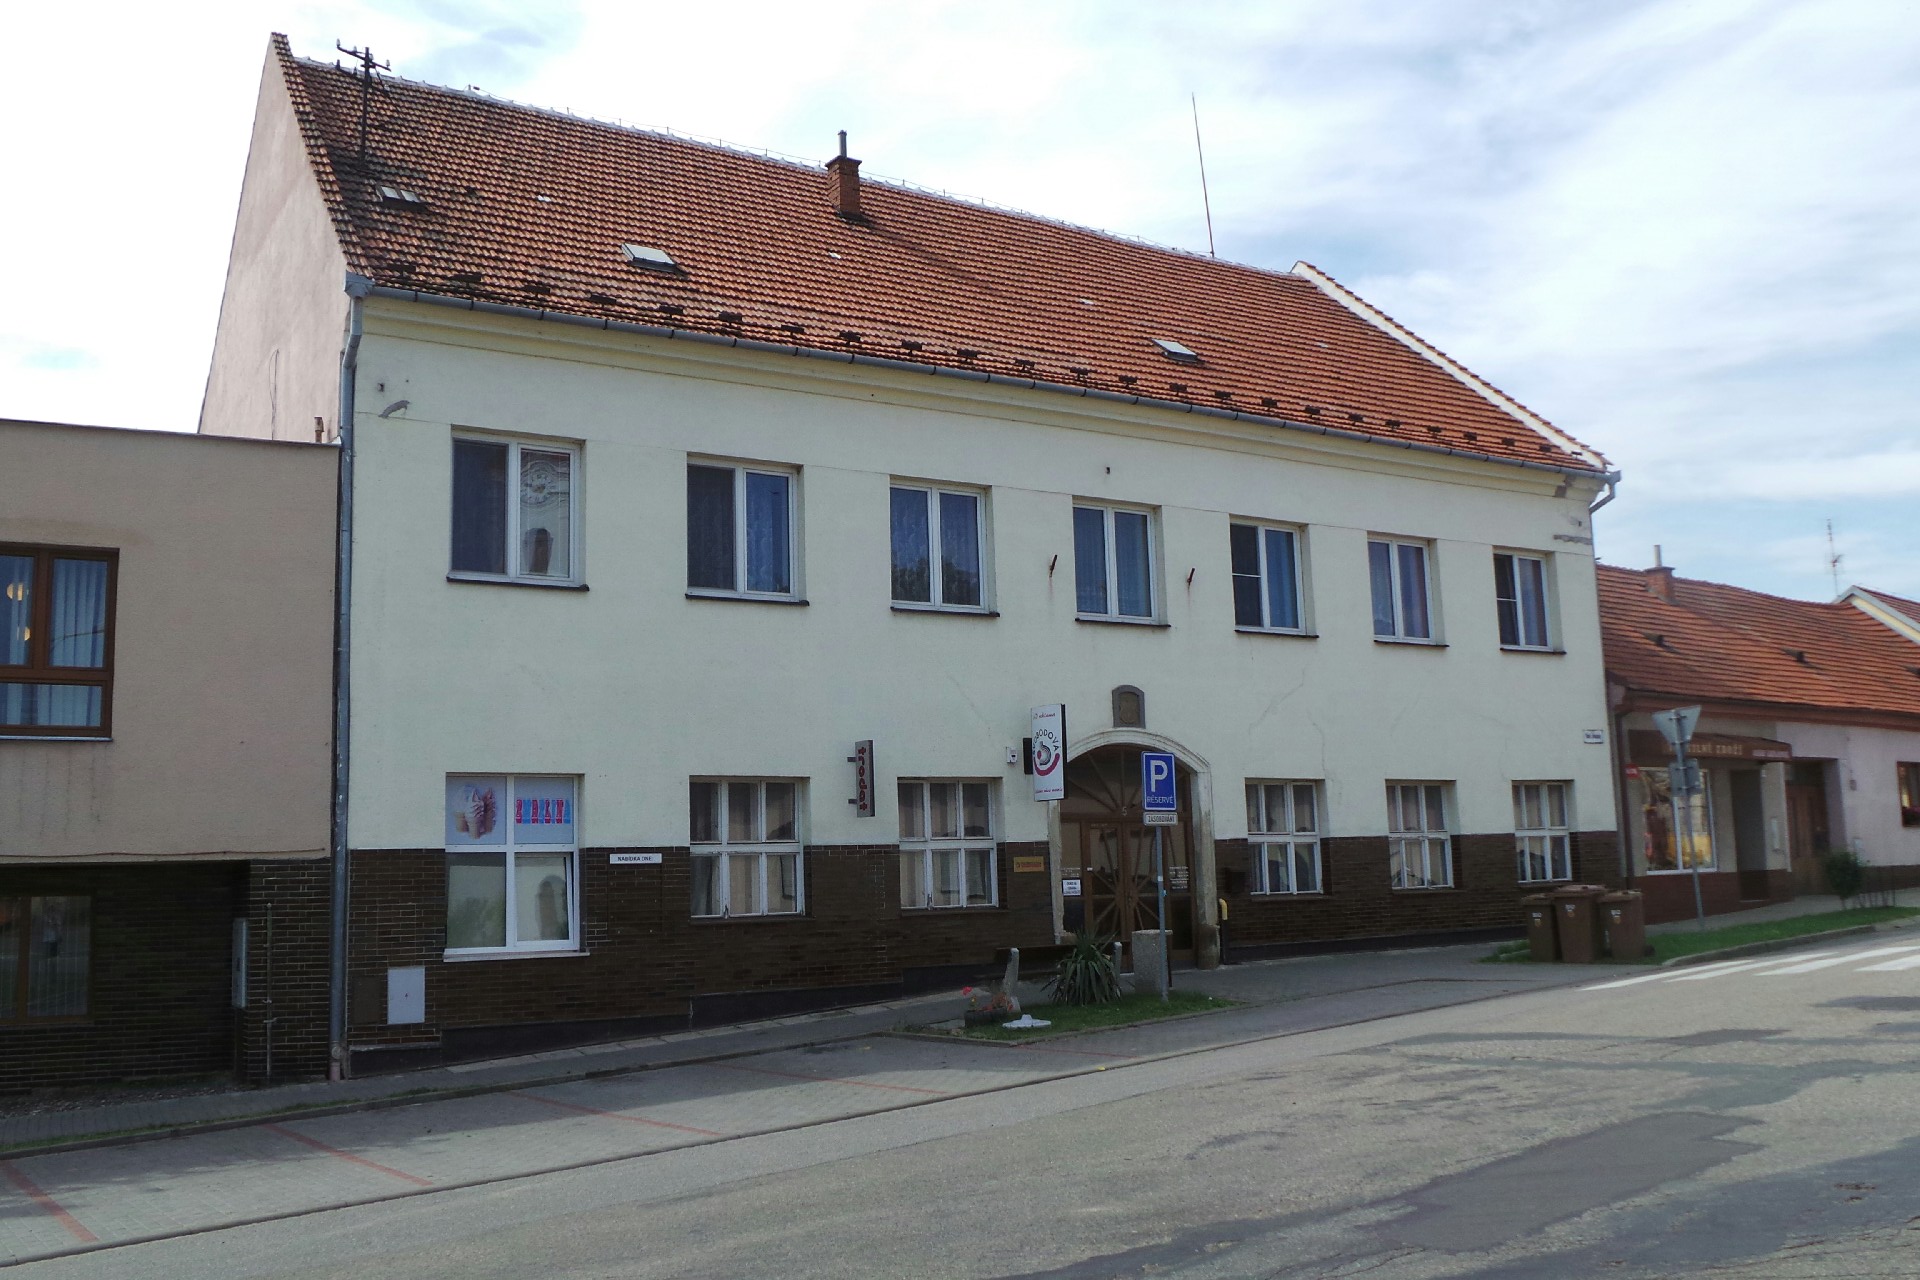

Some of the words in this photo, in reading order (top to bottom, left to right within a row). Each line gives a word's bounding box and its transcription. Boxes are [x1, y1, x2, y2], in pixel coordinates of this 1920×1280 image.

[858, 746, 868, 811] trodat
[1150, 760, 1168, 792] P
[1121, 806, 1128, 816] 5
